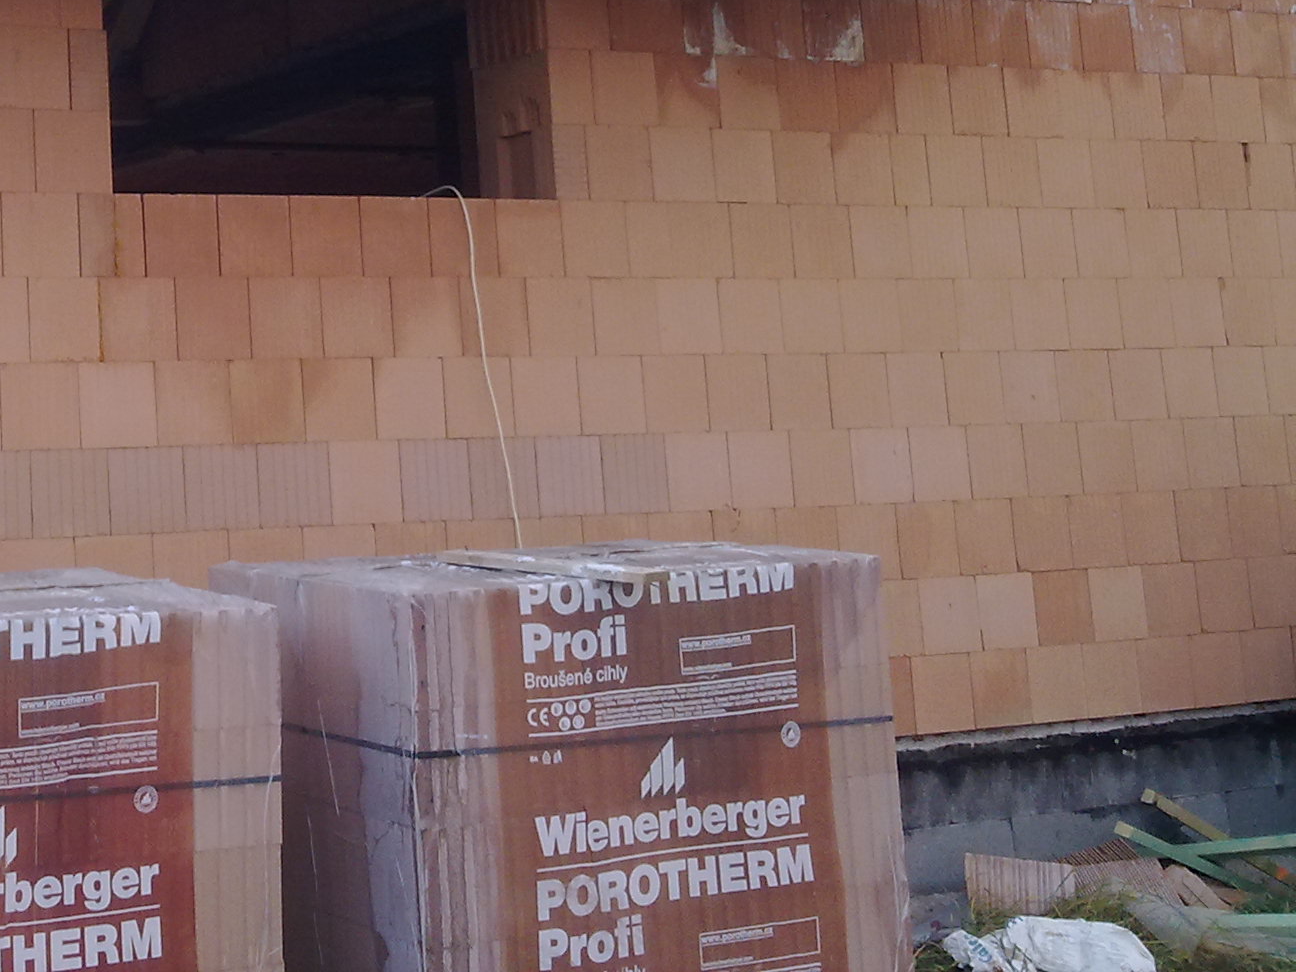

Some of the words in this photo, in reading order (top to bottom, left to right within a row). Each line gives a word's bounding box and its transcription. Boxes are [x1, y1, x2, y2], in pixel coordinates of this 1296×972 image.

[520, 613, 628, 664] Profi
[524, 668, 594, 689] Broušené
[595, 664, 628, 684] cihly
[534, 794, 806, 858] Wienerberger
[536, 843, 815, 922] POROTHERM
[537, 914, 645, 971] Profi
